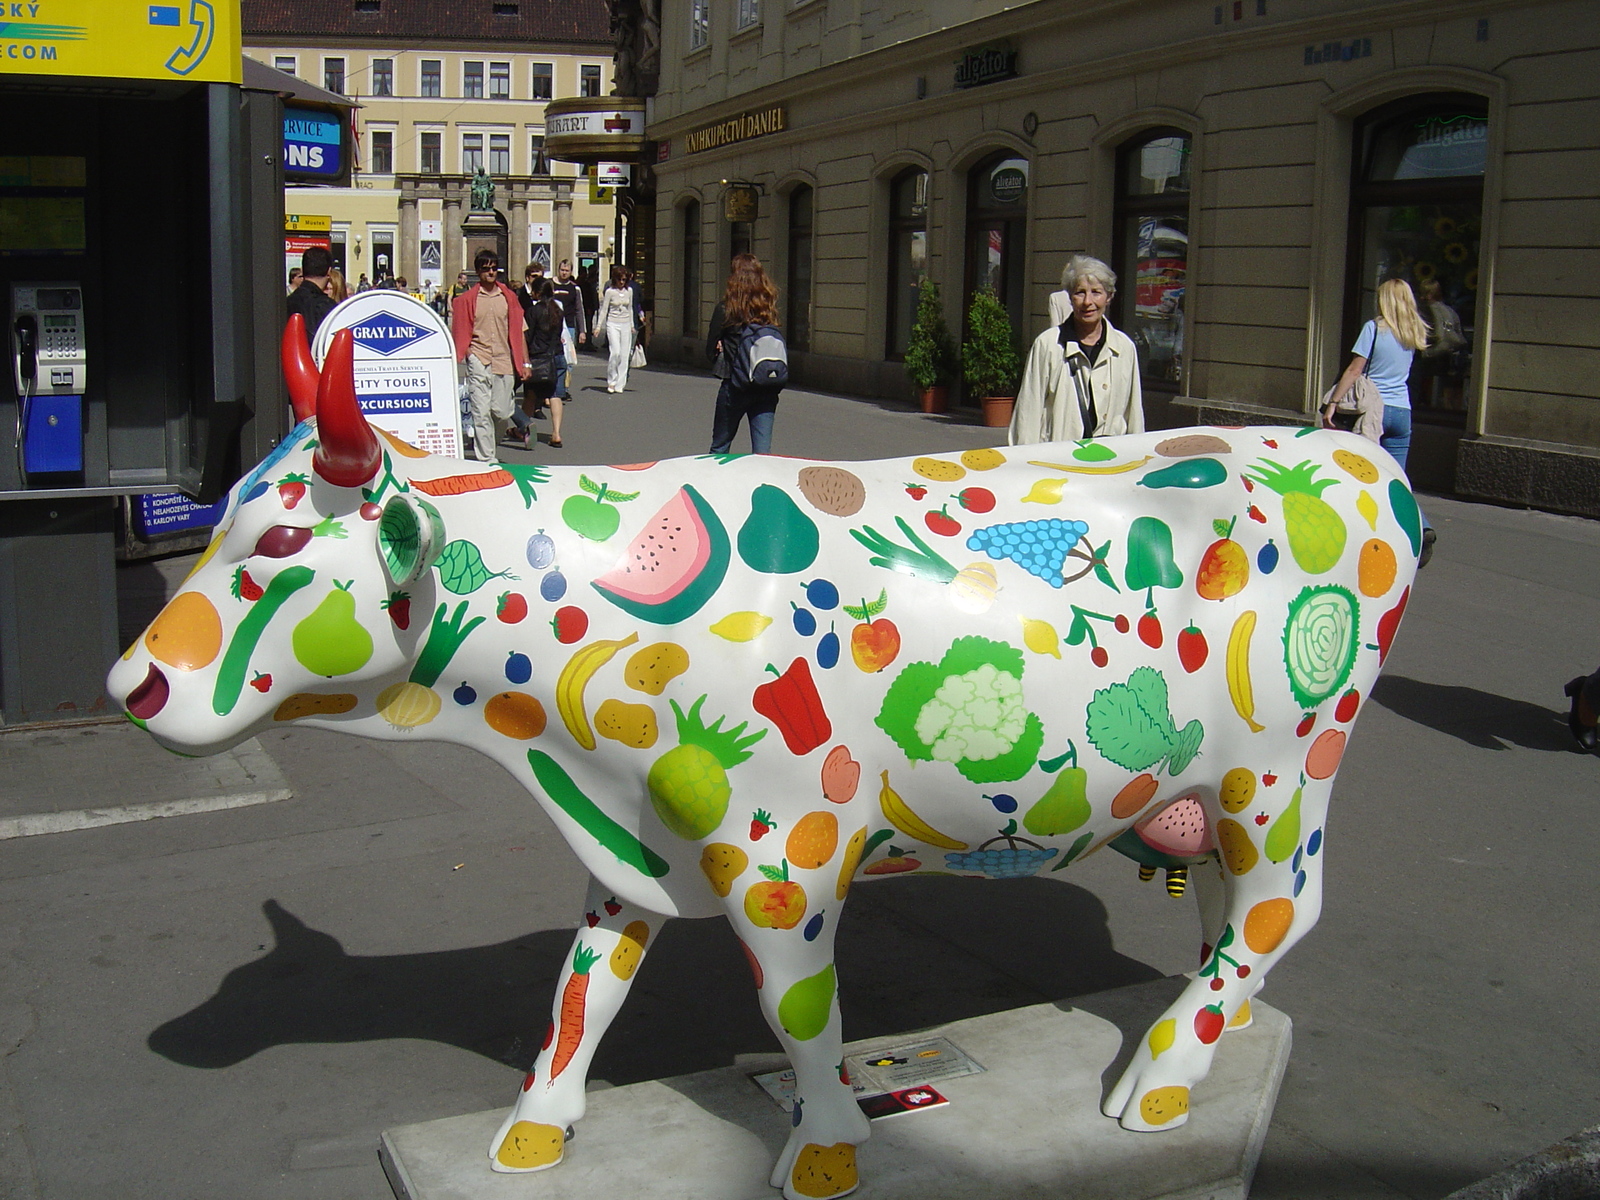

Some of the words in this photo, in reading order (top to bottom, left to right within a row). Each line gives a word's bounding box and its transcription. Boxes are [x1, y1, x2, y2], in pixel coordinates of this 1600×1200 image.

[0, 44, 57, 60] COM
[685, 113, 745, 154] KNIHKUPECTVÍ
[747, 107, 783, 137] DANIEL
[284, 144, 324, 168] NS
[353, 326, 386, 339] GRAY
[388, 326, 417, 339] LINE
[354, 379, 380, 389] CITY
[384, 377, 427, 388] TOURS
[357, 398, 430, 410] XCURSIONS
[153, 515, 177, 525] KARLOVY
